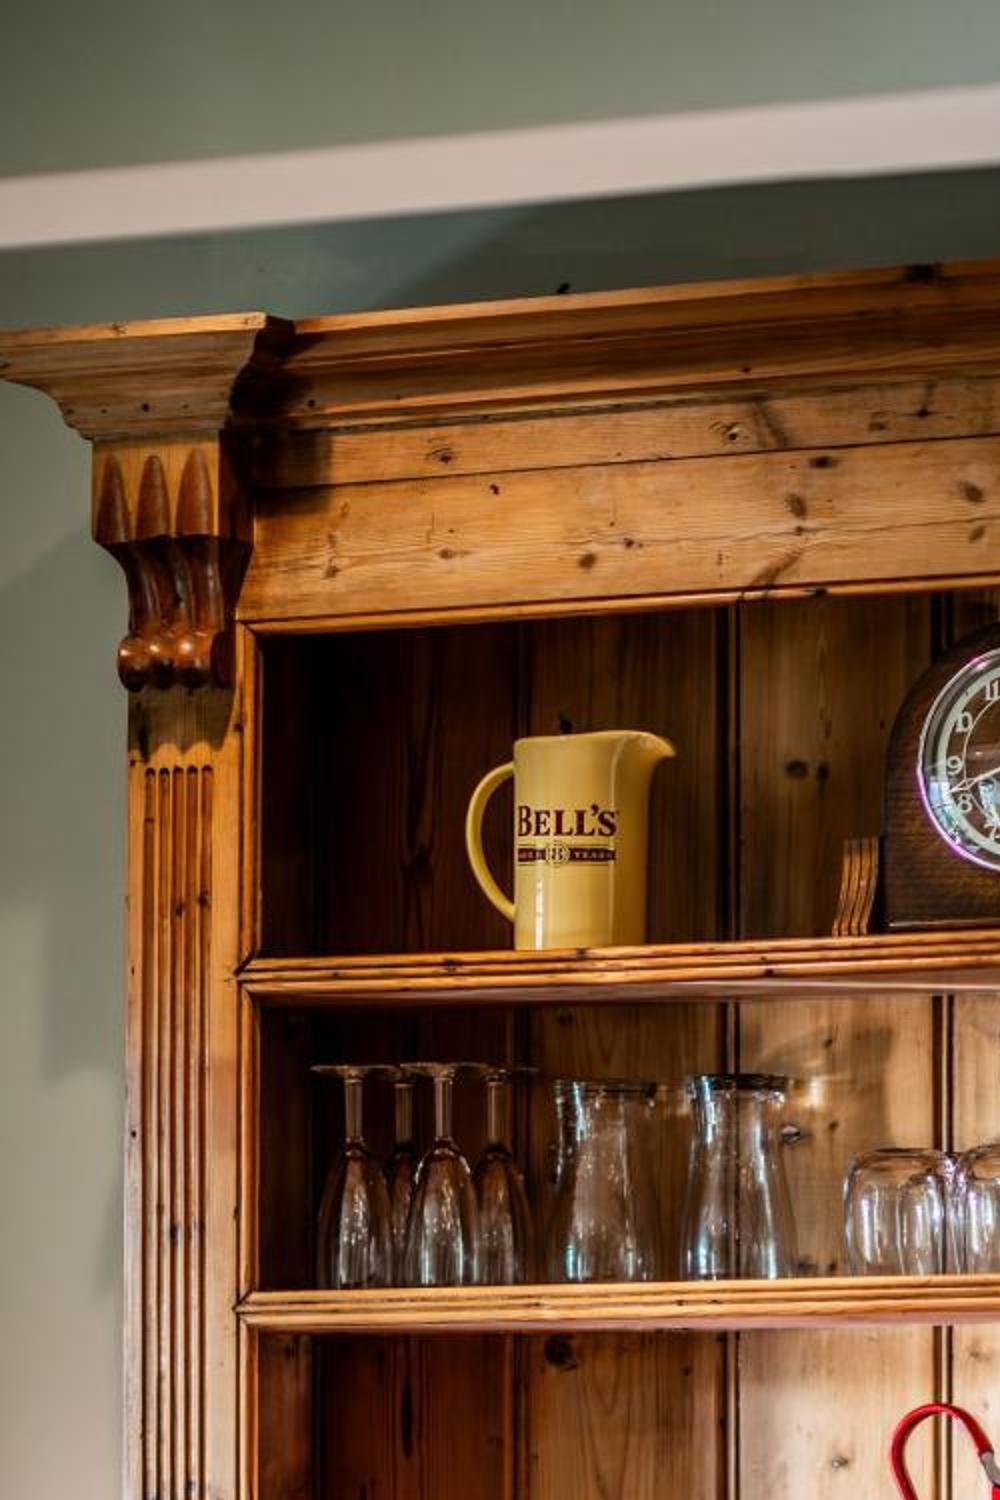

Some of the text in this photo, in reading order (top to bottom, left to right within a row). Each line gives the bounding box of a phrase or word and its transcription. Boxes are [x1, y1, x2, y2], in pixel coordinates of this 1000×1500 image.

[985, 680, 999, 701] 11
[955, 711, 973, 733] 10
[947, 755, 962, 775] 9
[958, 793, 973, 813] 8
[518, 804, 616, 836] BELL'S
[983, 823, 1000, 841] 7
